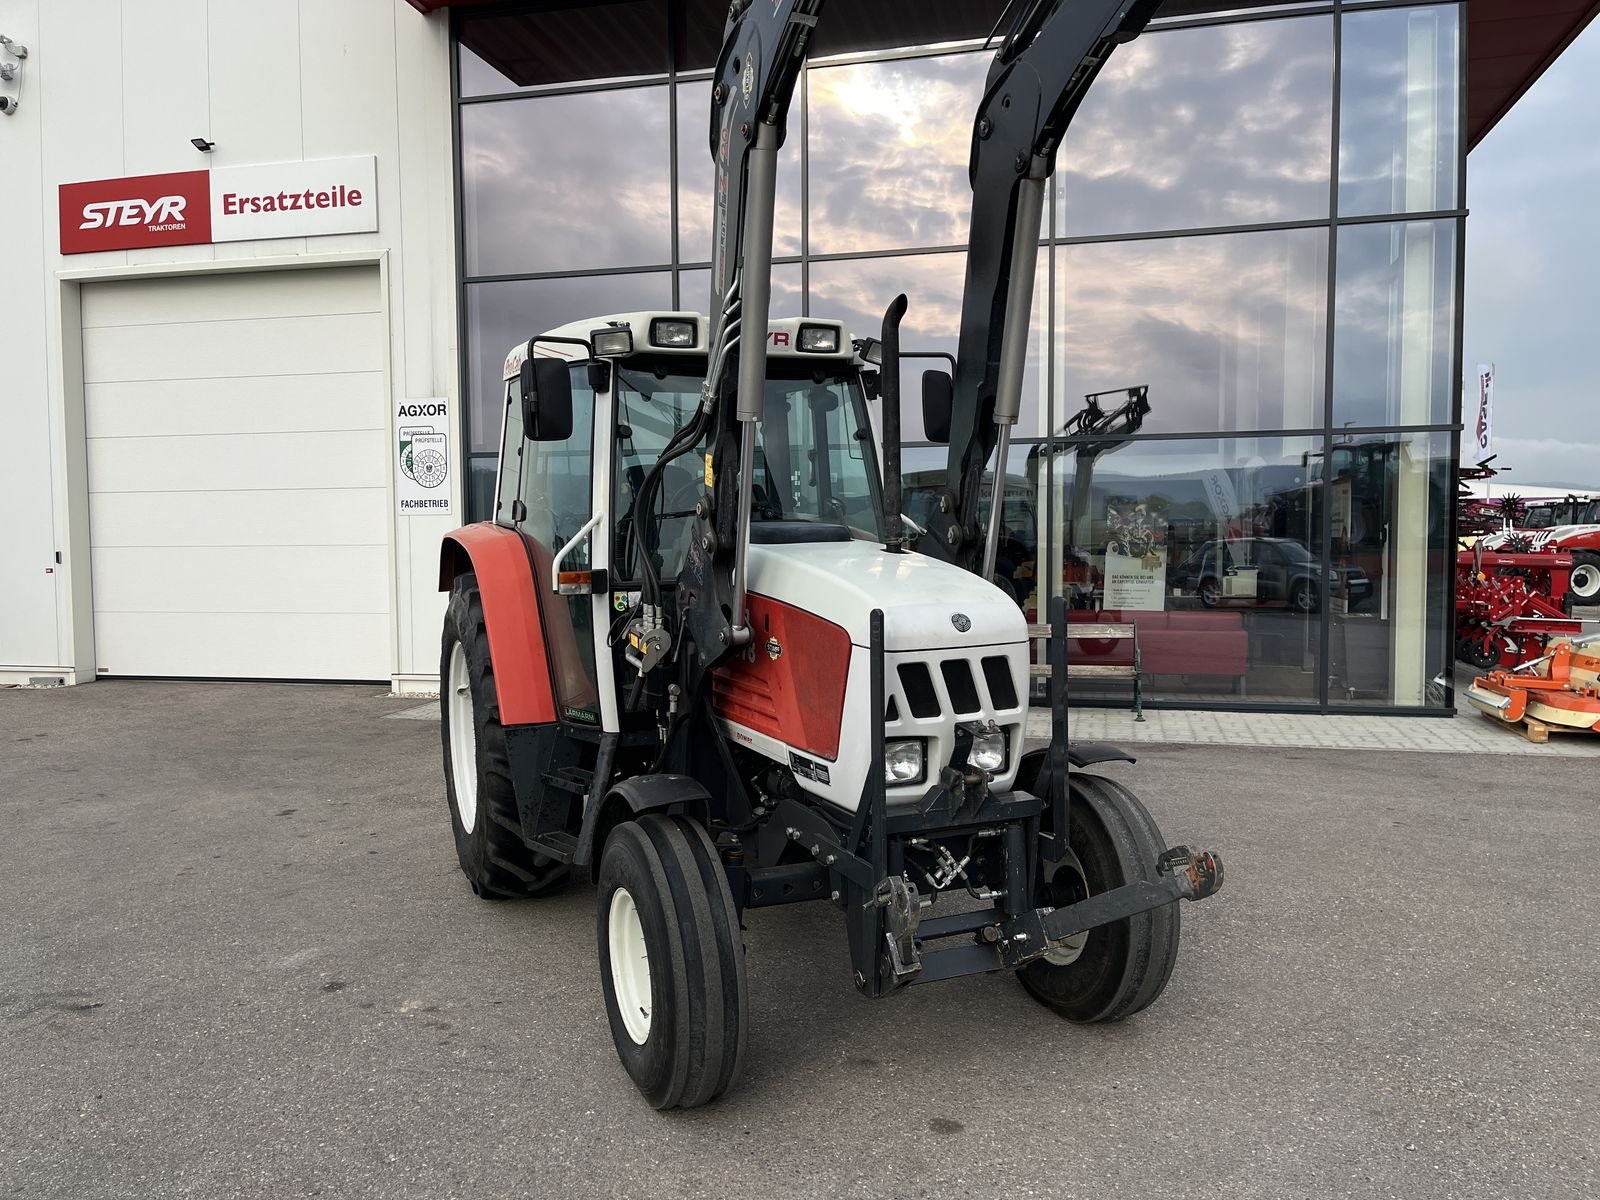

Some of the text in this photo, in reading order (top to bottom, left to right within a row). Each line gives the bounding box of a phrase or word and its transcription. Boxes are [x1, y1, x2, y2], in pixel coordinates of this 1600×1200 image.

[222, 185, 363, 216] Ersatzteile
[79, 195, 187, 230] STEYR
[148, 222, 186, 232] TRAKTOREN
[398, 404, 447, 417] AGXOR
[400, 499, 449, 508] FACHBETRIEB
